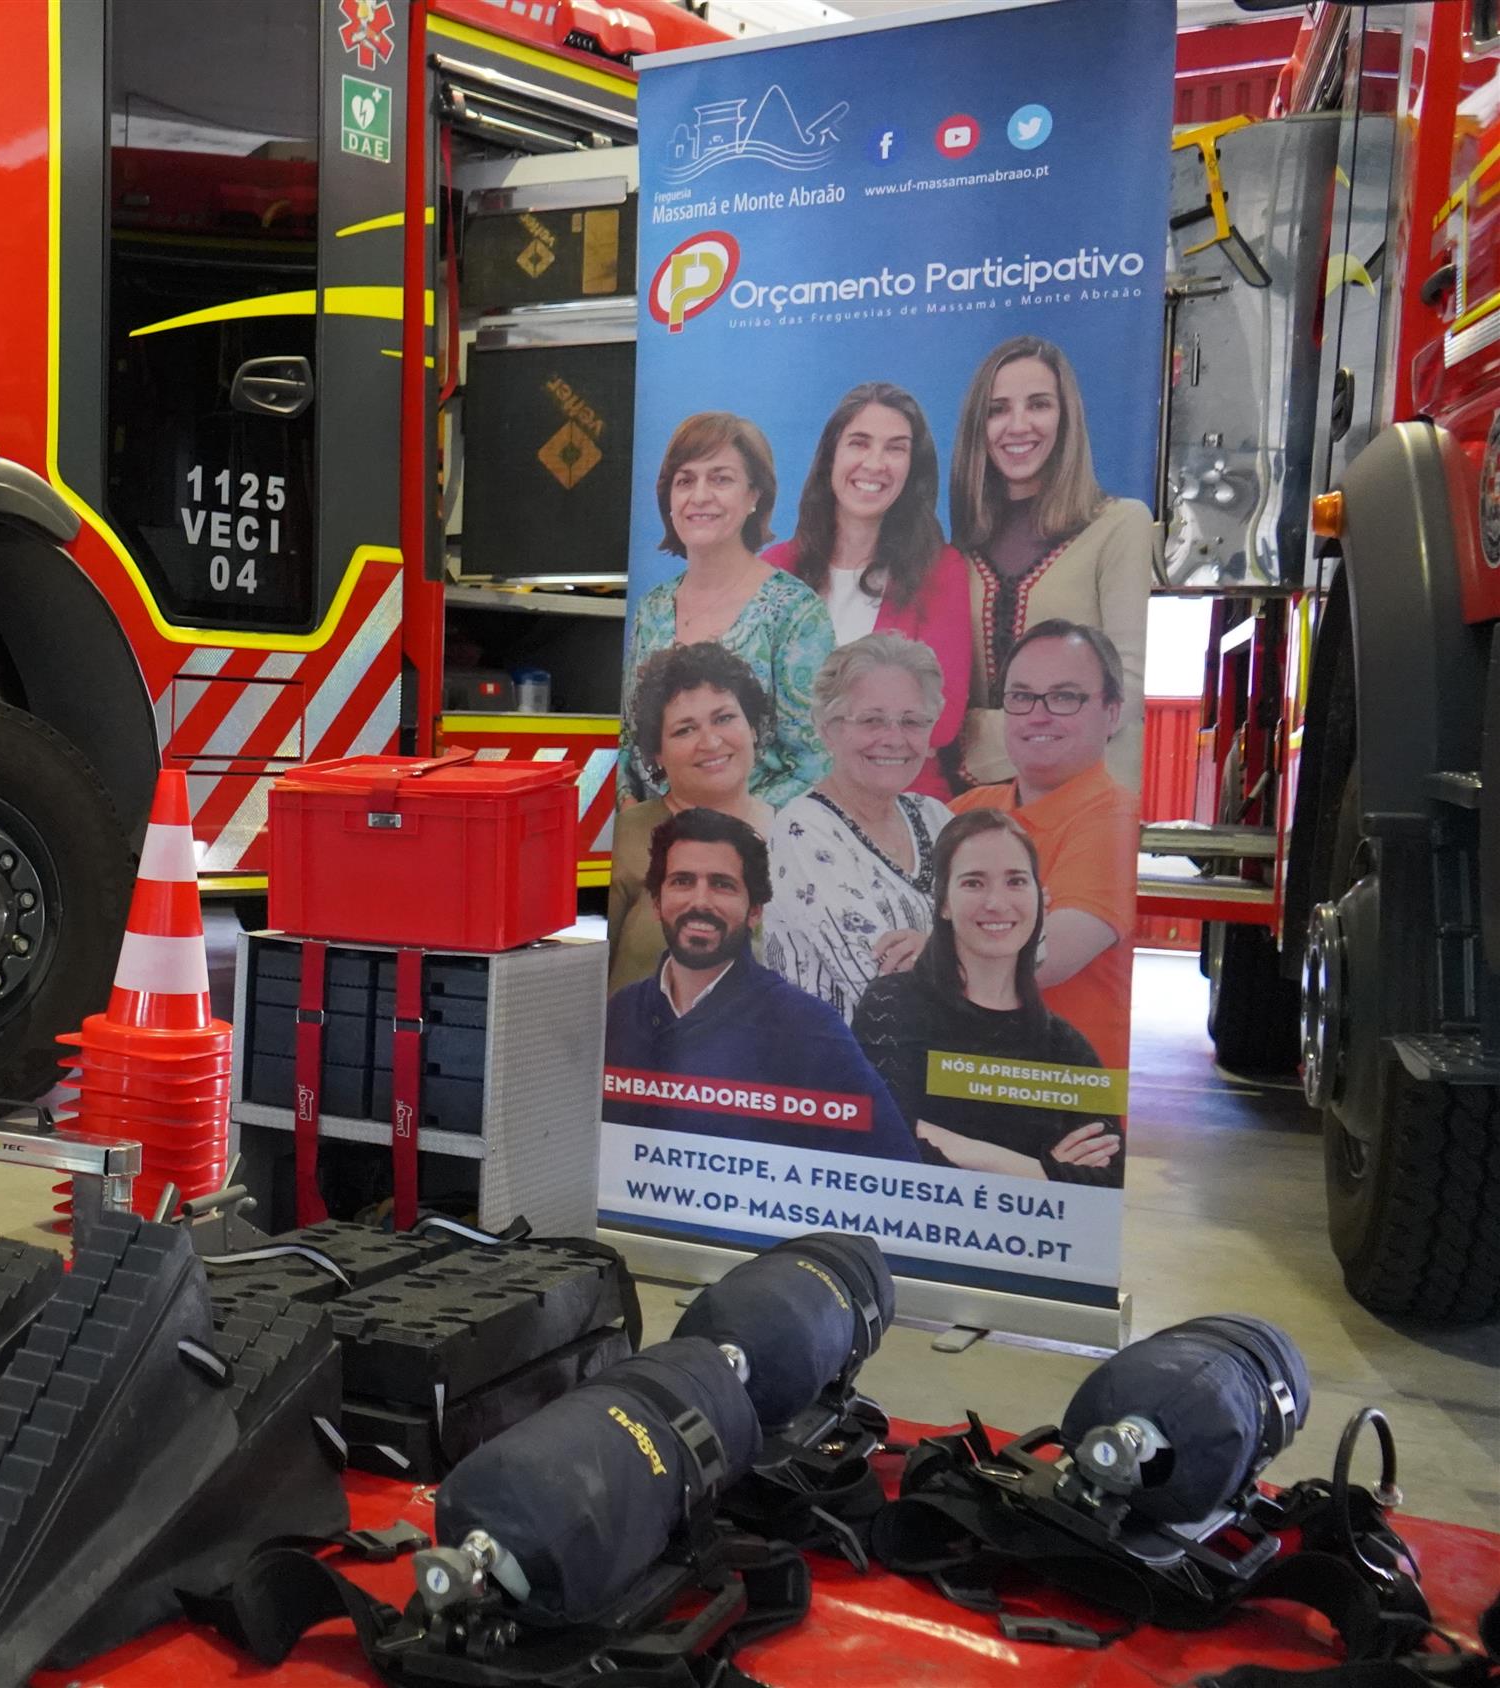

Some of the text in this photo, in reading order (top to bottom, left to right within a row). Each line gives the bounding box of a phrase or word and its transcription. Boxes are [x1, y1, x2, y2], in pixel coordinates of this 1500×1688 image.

[348, 132, 384, 157] DAE
[654, 187, 692, 203] Freguesia
[864, 165, 1050, 197] www.uf-massamamabraao.pt
[652, 183, 846, 225] Massamá e Monte Abraão
[729, 247, 1145, 314] Orçamento Participativo
[729, 287, 1142, 329] União das Freguesias de Massamá e Monte Abraão
[187, 464, 286, 512] 1125
[181, 507, 280, 554] VECI
[209, 555, 258, 595] 04
[940, 1057, 1111, 1088] NÓS APRESENTÁMOS
[968, 1081, 1079, 1106] UM PROJETO!
[603, 1074, 858, 1121] EMBAIXADORES DO OP
[633, 1143, 1065, 1220] PARTICIPE, A FREGUESIA É SUA!
[626, 1179, 1073, 1263] WWW.OP-MASSAMAMABRAAO.PT
[607, 1405, 668, 1476] Dräger
